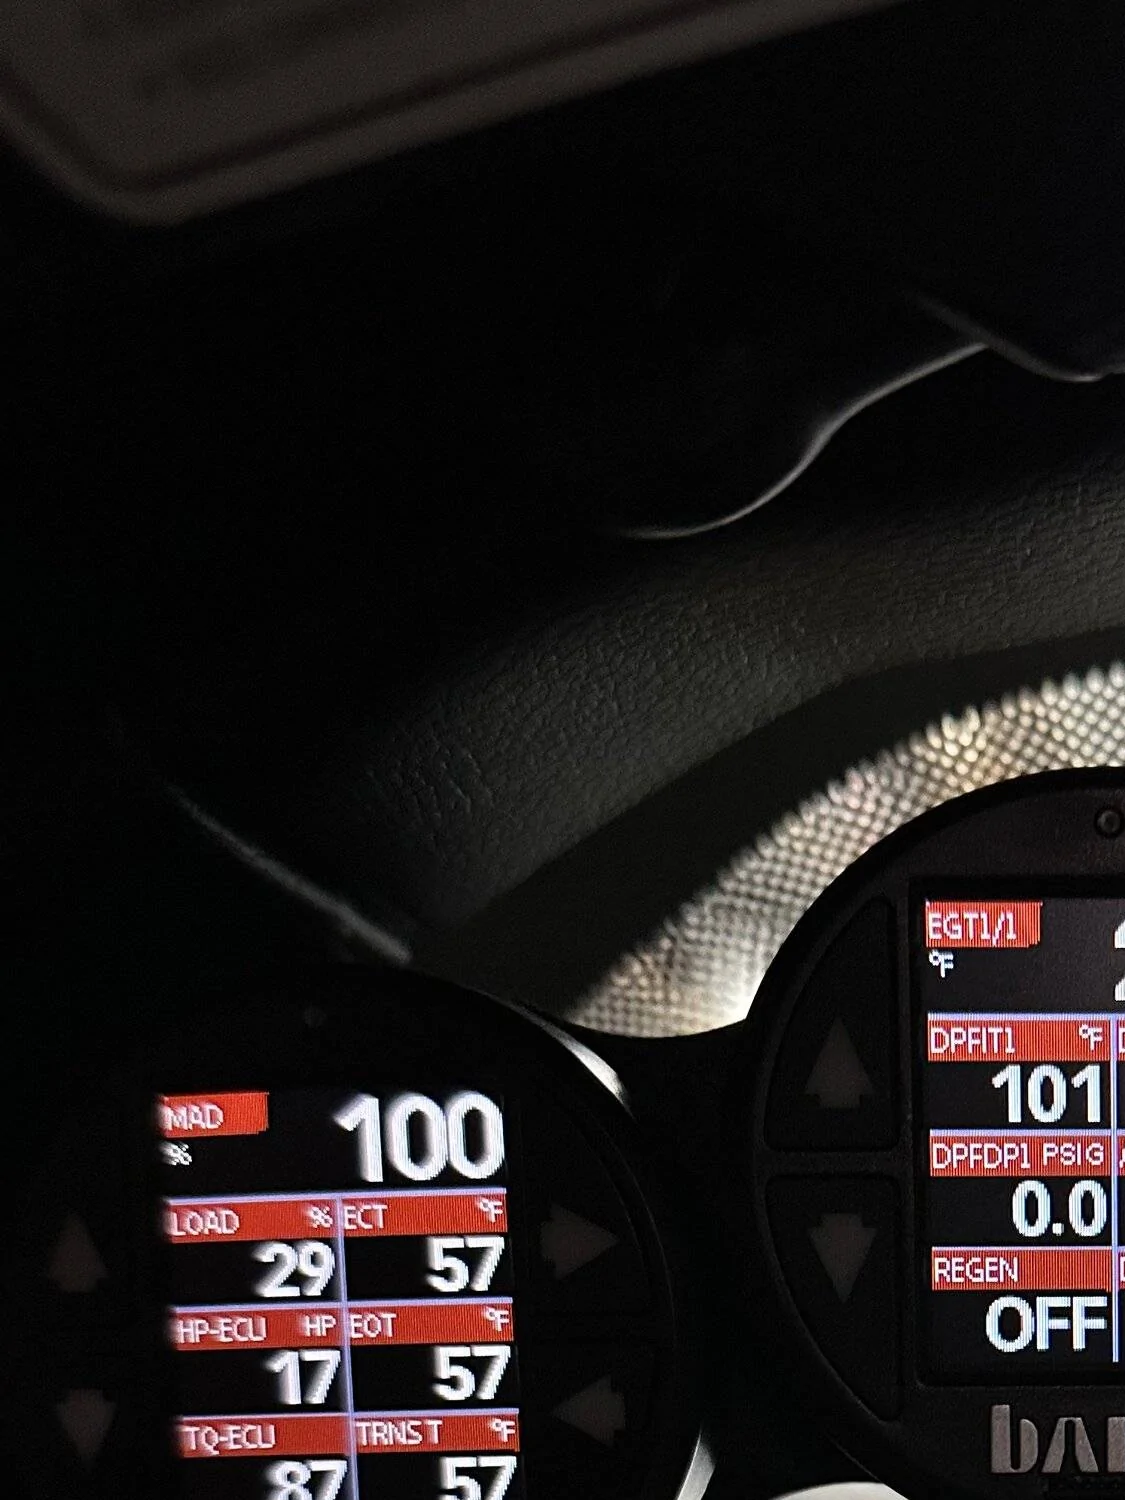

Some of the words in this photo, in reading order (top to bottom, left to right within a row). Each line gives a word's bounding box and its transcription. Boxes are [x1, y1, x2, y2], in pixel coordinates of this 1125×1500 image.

[928, 912, 1018, 946] EGT1/1
[929, 1027, 1016, 1054] DPFIT1
[991, 1063, 1101, 1123] 101
[163, 1102, 224, 1130] MAD
[334, 1090, 505, 1182] 100
[165, 1142, 193, 1166] %
[931, 1143, 1031, 1169] DPFDP1
[1043, 1143, 1105, 1166] PSIG
[169, 1210, 240, 1236] LOAD
[308, 1206, 333, 1228] %
[343, 1204, 388, 1230] ECT
[1011, 1180, 1107, 1237] 0.0
[252, 1240, 336, 1297] 29
[426, 1236, 504, 1292] 57
[934, 1257, 1018, 1283] REGEN
[176, 1316, 267, 1344] HP-ECU
[304, 1314, 336, 1337] HP
[350, 1313, 397, 1338] EOT
[985, 1295, 1107, 1353] OFF
[263, 1349, 341, 1405] 17
[432, 1345, 511, 1400] 57
[181, 1423, 276, 1455] TQ-ECU
